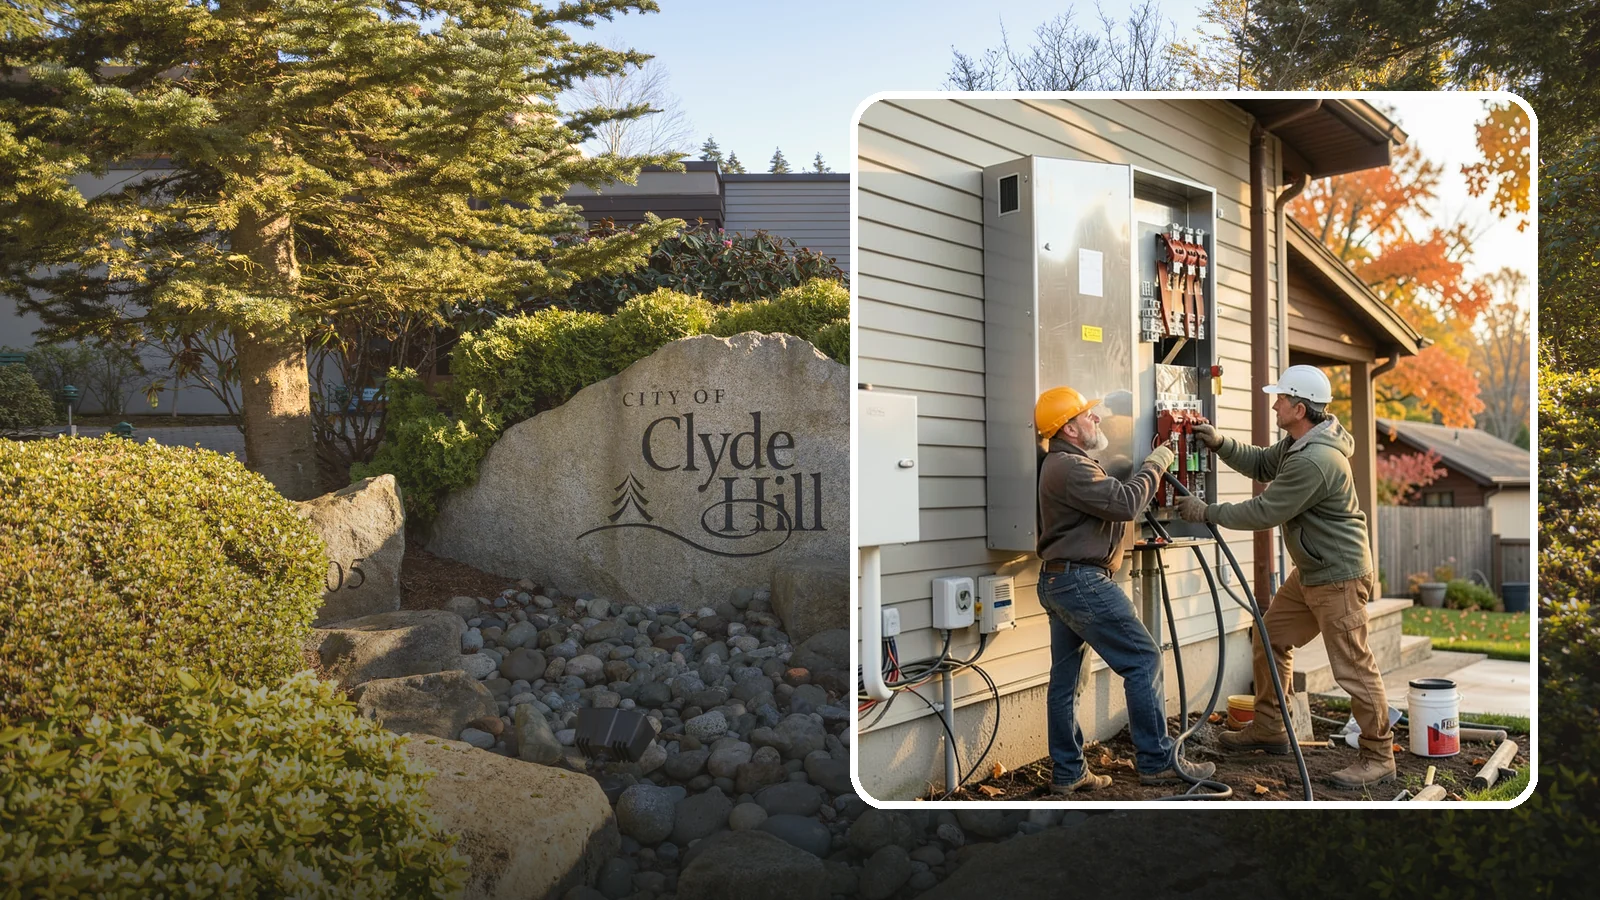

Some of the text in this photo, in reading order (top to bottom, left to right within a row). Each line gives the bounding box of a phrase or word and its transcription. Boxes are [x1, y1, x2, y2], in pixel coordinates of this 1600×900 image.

[622, 388, 725, 407] CITY OF
[641, 410, 796, 493] Clyde
[718, 471, 828, 532] Hill
